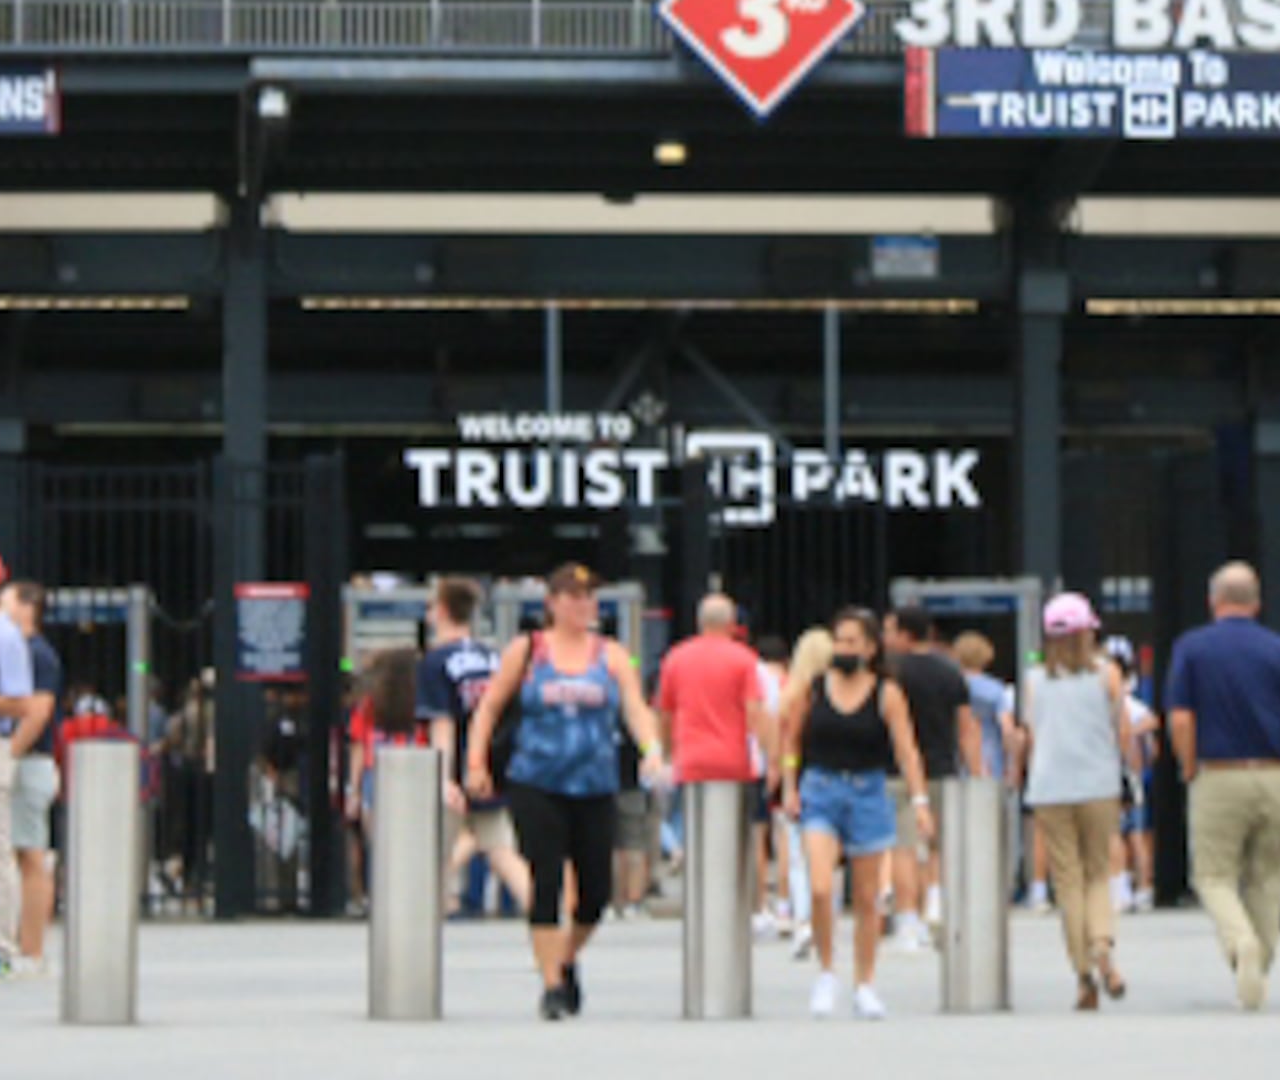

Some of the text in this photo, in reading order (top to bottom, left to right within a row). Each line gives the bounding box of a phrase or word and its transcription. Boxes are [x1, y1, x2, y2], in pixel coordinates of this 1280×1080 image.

[1032, 51, 1229, 86] Welcome To
[975, 92, 1118, 129] TRUIST
[459, 414, 632, 441] WELCOME TO
[407, 449, 980, 508] TRUIST PARK
